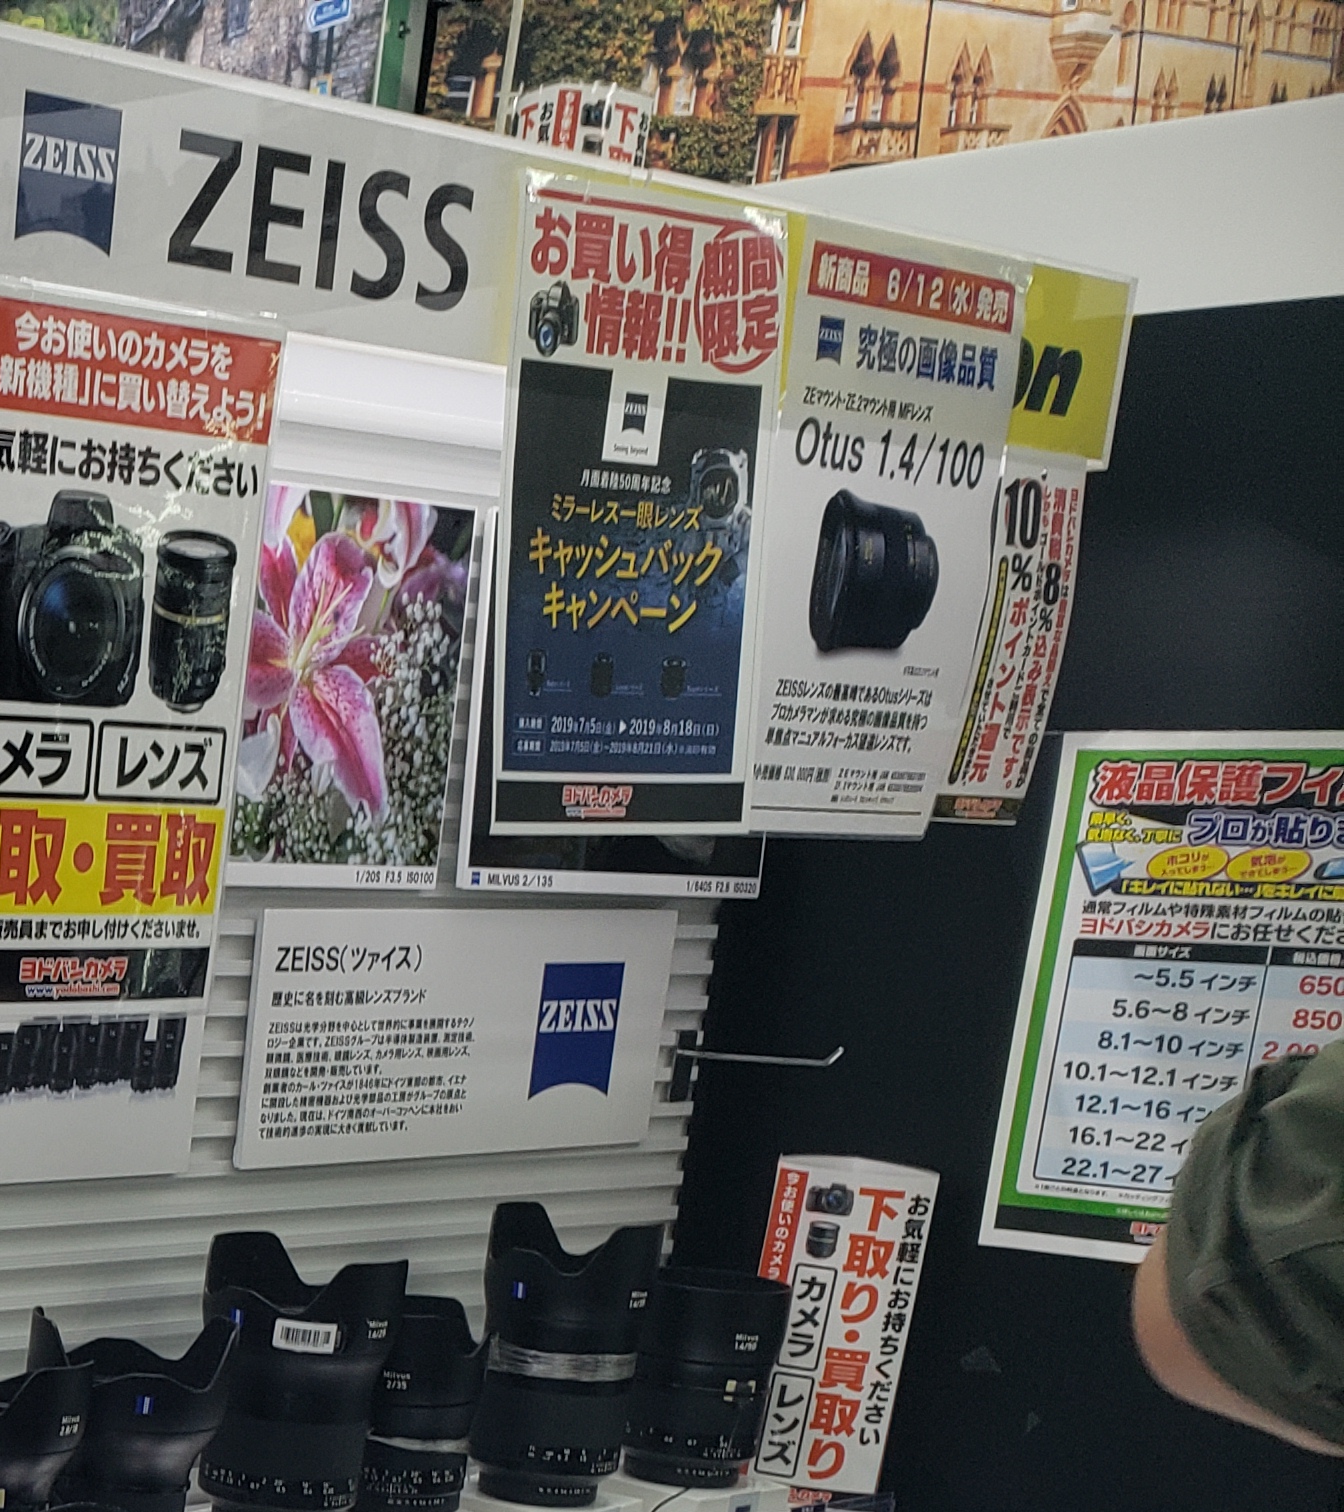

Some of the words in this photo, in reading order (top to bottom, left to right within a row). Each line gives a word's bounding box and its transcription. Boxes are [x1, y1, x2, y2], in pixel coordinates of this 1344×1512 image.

[21, 132, 116, 183] ZEISS
[167, 128, 474, 311] ZEISS
[531, 206, 694, 295] お買い得
[703, 236, 778, 300] 期間
[818, 252, 870, 297] 新商品
[14, 311, 233, 382] 今お使いのカメラを
[702, 295, 779, 363] 限定
[819, 328, 843, 342] ZEISS
[856, 324, 998, 391] 究極の画像品質
[796, 416, 865, 473] Otus
[879, 429, 984, 489] 1.4/100
[529, 528, 723, 587] キャッシュバック
[543, 581, 697, 634] キャンペーン
[116, 736, 213, 790] レンズ
[1093, 760, 1344, 807] 液晶保護フィ
[355, 870, 381, 884] 1/20S
[406, 872, 434, 885] ISO100
[487, 873, 521, 886] MILVUS
[523, 874, 553, 888] 2/135
[20, 957, 128, 983] ヨドバシカメラ
[539, 999, 617, 1033] ZEISS
[787, 1276, 826, 1359] カメラ
[762, 1384, 804, 1467] レンズ
